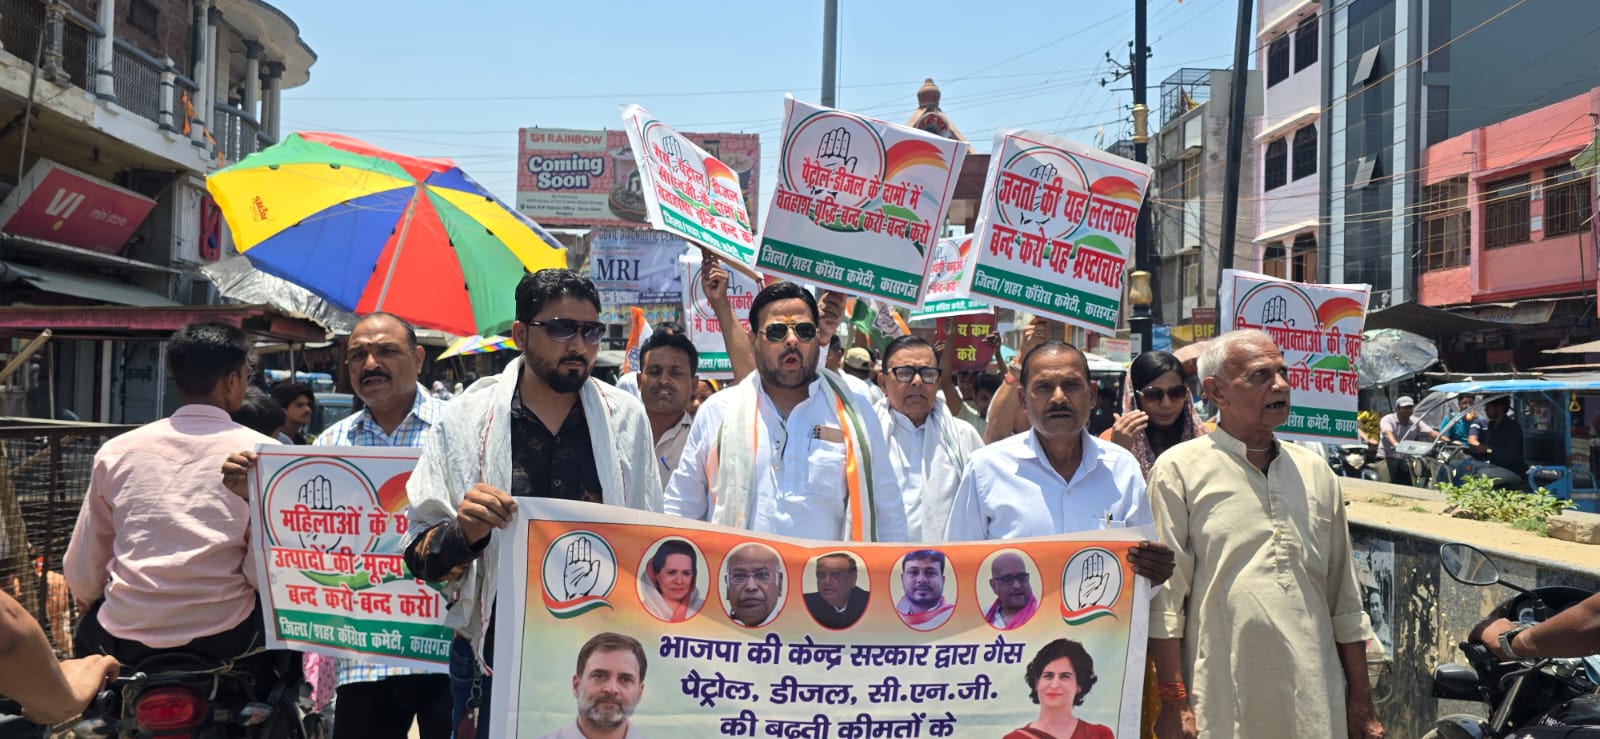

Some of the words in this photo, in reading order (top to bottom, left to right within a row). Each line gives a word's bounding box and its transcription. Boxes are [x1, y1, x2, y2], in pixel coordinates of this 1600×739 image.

[547, 134, 603, 144] RAINBOW
[528, 152, 604, 177] Coming
[537, 172, 590, 189] Soon
[868, 175, 881, 199] के
[882, 182, 910, 207] दामों
[910, 184, 924, 210] में
[998, 171, 1042, 212] जनता
[1039, 176, 1063, 219] की
[1064, 189, 1089, 225] यह
[1087, 195, 1139, 239] ललकार
[909, 218, 931, 244] करो
[596, 258, 640, 281] MRI
[989, 223, 1017, 260] बन्द
[1018, 226, 1047, 269] करो
[1048, 240, 1074, 274] यह
[1072, 246, 1126, 290] भ्रष्टाचार
[880, 278, 919, 299] कासगंज
[1084, 302, 1118, 323] कासगंज
[971, 324, 990, 336] कम
[1266, 321, 1324, 354] पभोक्ताओं
[1325, 327, 1342, 356] की
[957, 345, 977, 361] करो
[1335, 418, 1359, 433] कासग
[280, 504, 363, 535] महिलाओं
[368, 507, 387, 536] के
[271, 545, 328, 571] उत्पादों
[333, 546, 355, 575] की
[361, 553, 404, 584] मूल्य
[286, 584, 317, 606] बन्द
[370, 629, 405, 654] कमेटी,
[410, 634, 451, 657] कासगंज
[659, 635, 742, 664] भाजपा
[747, 633, 783, 665] की
[788, 635, 845, 671] केन्द्र
[850, 644, 930, 667] सरकार
[935, 643, 981, 669] द्वारा
[983, 635, 1026, 665] गैस
[680, 669, 760, 708] पैट्रोल,
[769, 675, 858, 707] डीजल,
[867, 673, 998, 705] सी.एन.जी.
[720, 709, 758, 737] की
[837, 712, 928, 739] कीमतों
[929, 711, 957, 738] के
